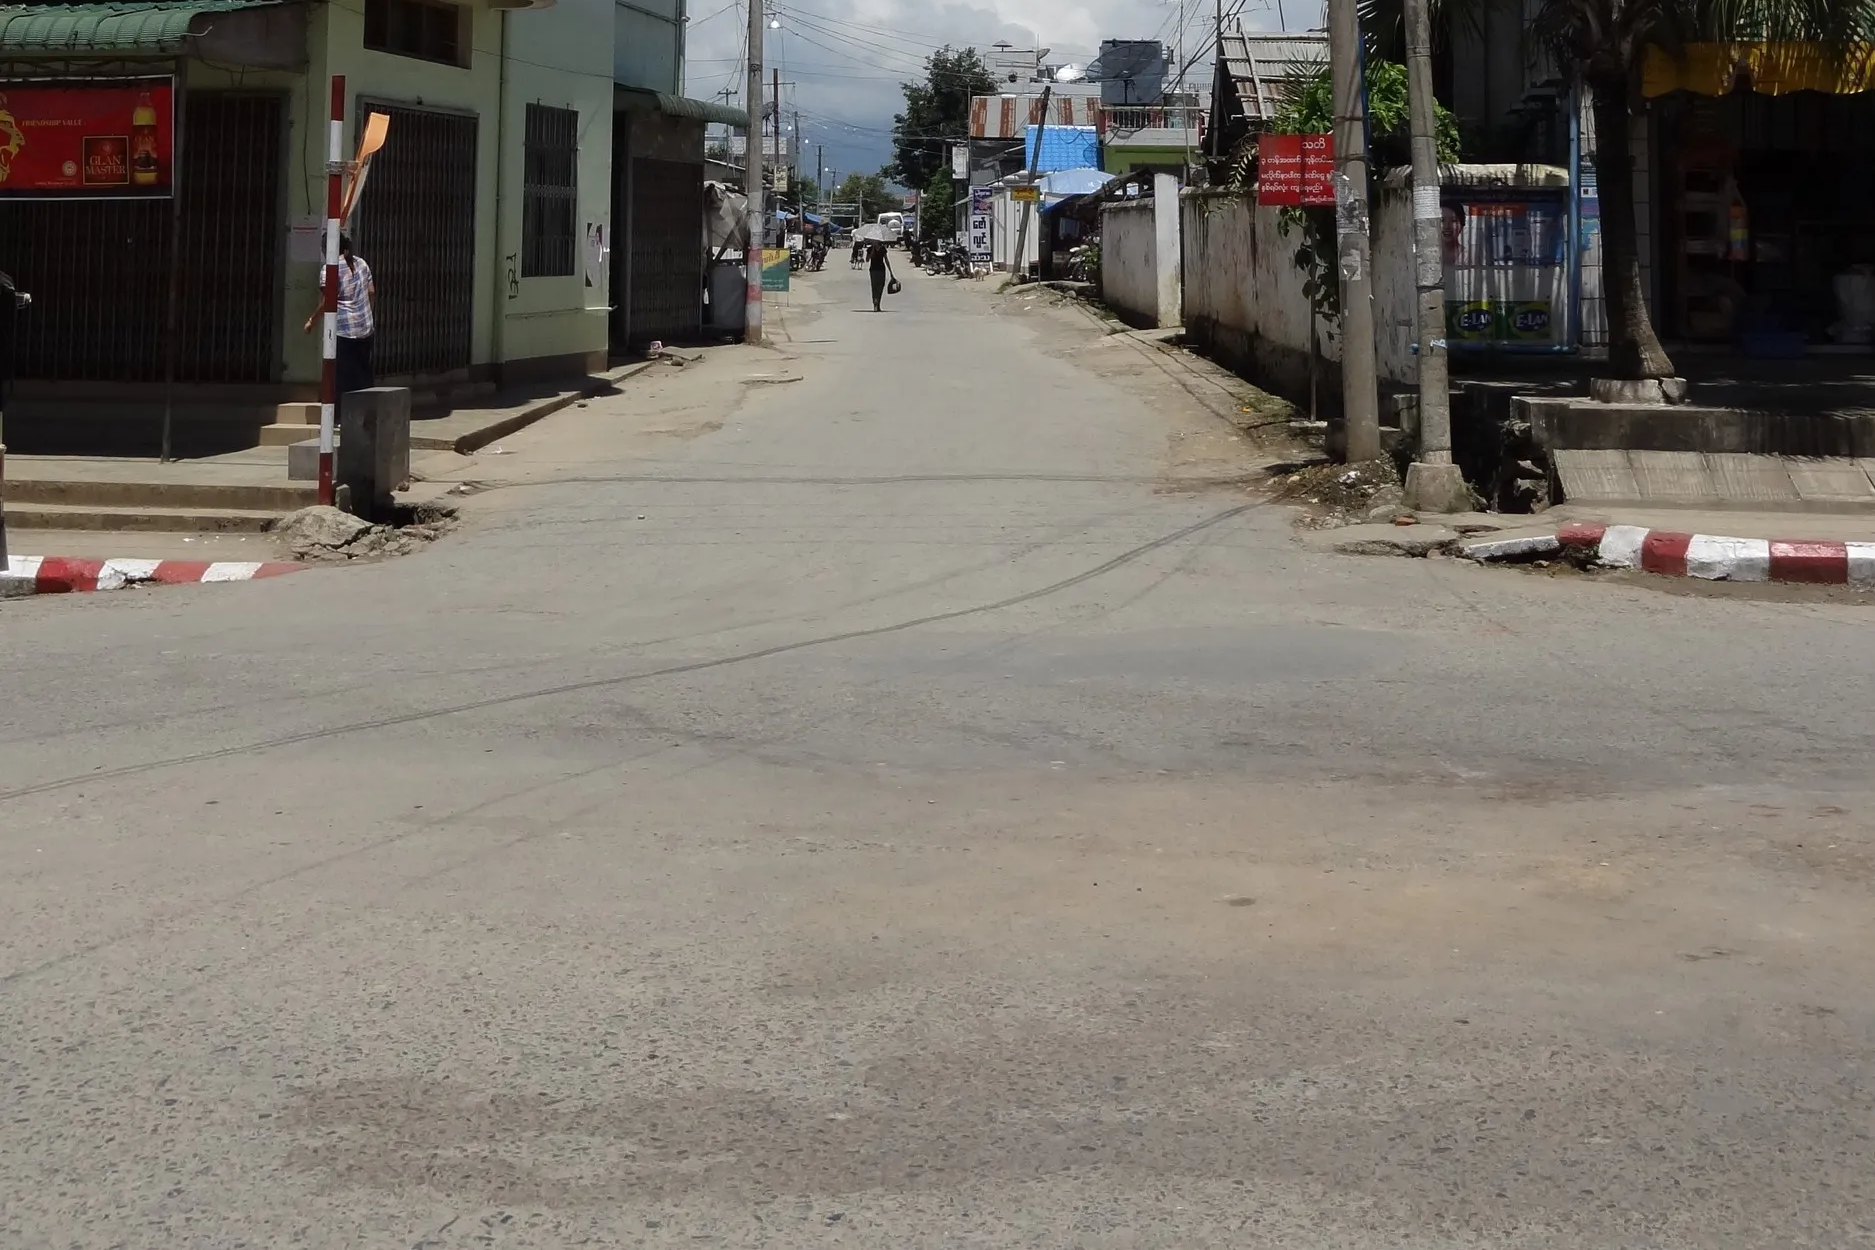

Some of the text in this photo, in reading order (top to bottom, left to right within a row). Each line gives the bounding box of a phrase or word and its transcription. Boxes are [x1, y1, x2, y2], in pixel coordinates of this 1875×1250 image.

[1302, 137, 1326, 149] သတိ
[85, 166, 127, 175] MASTER
[1460, 313, 1549, 327] E-LAN E-LAN
